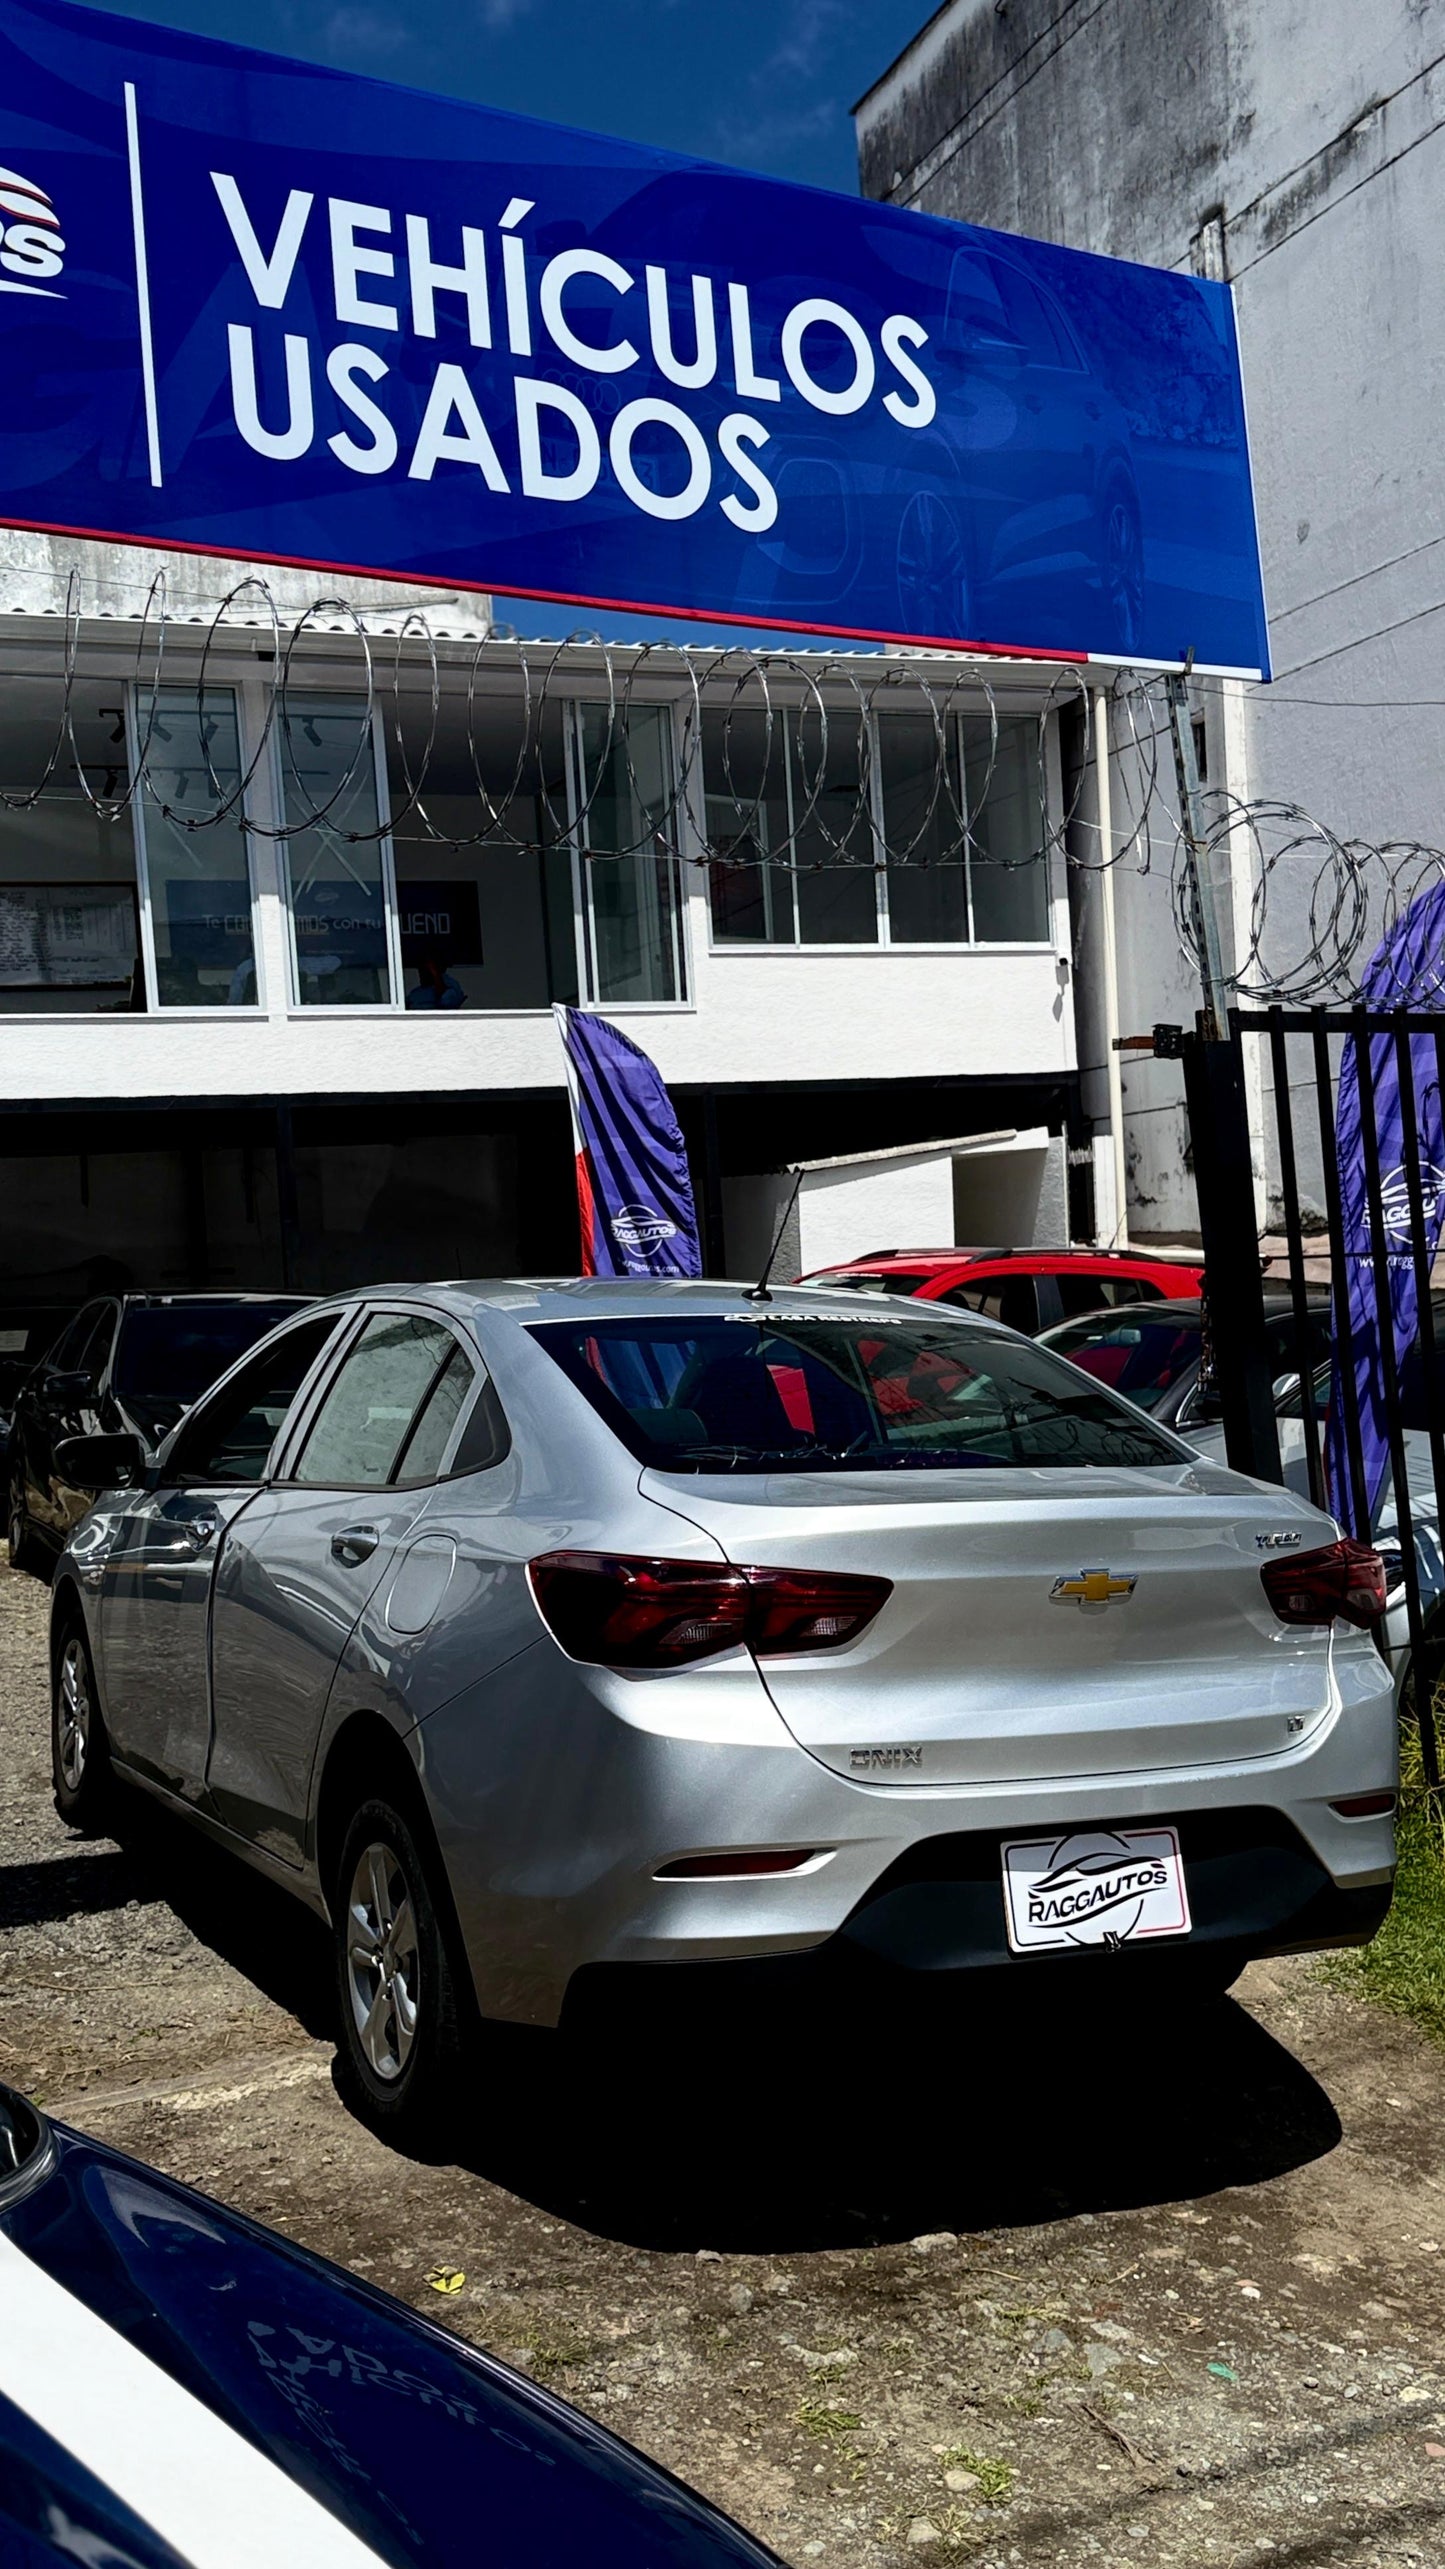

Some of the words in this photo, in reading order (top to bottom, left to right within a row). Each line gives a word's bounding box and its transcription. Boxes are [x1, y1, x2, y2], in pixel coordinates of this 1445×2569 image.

[209, 171, 938, 429] VEHÍCULOS
[227, 322, 779, 533] USADOS
[333, 919, 360, 930] con
[388, 913, 451, 935] UENO
[850, 1747, 922, 1767] ONIX
[1028, 1870, 1168, 1923] RAGGAUTOS
